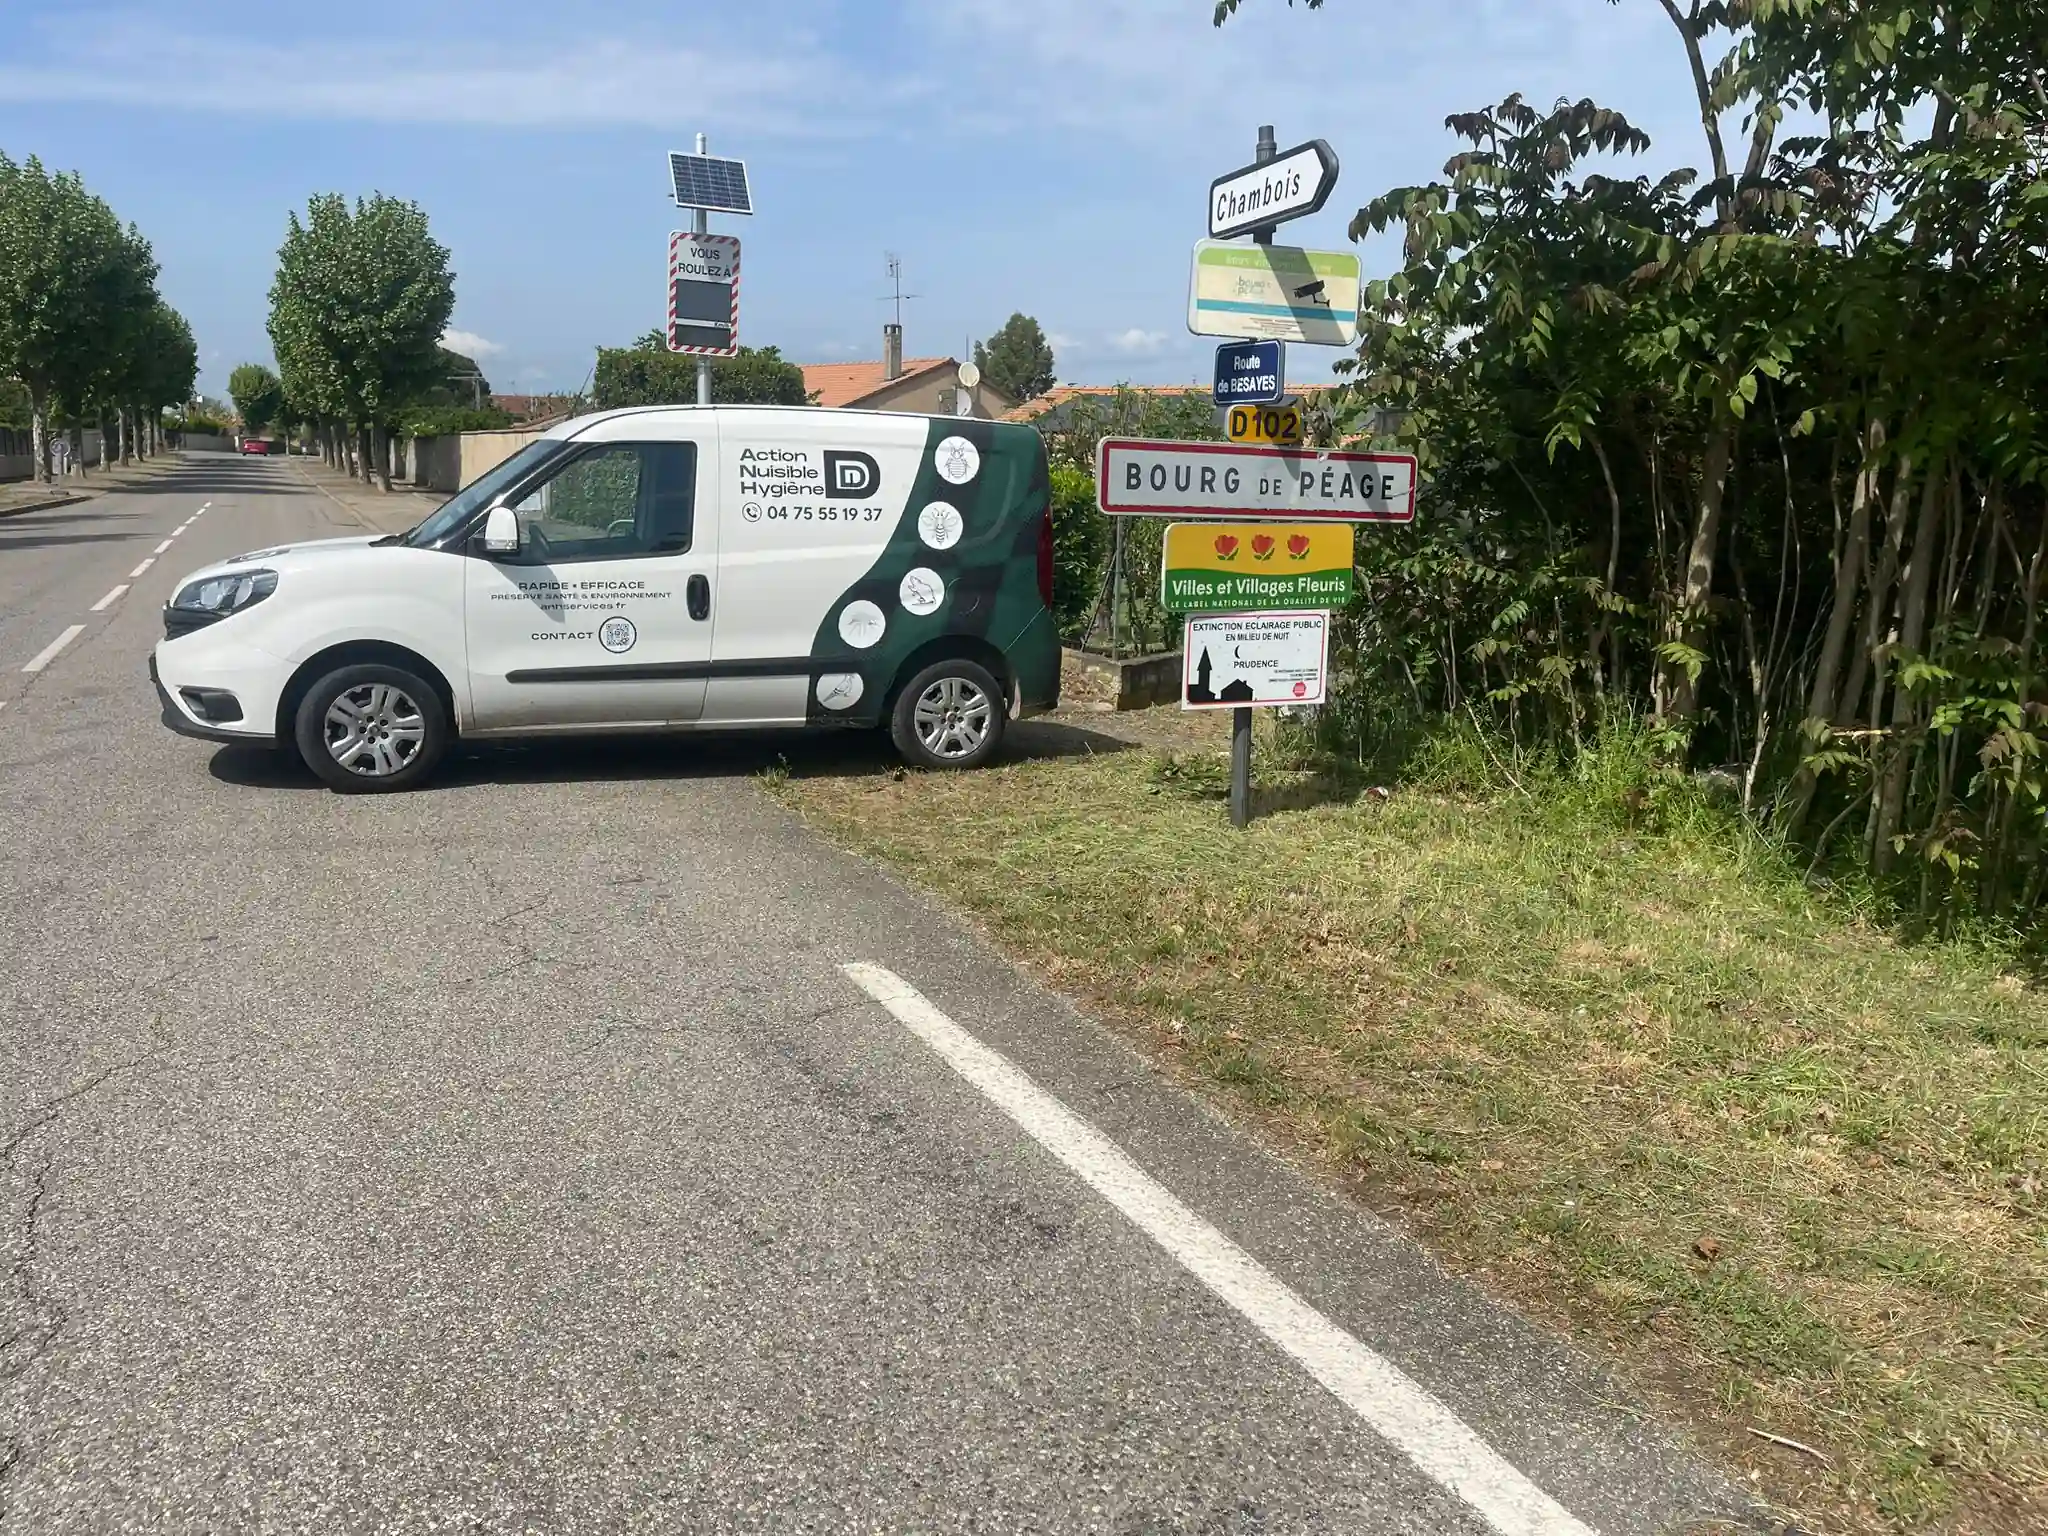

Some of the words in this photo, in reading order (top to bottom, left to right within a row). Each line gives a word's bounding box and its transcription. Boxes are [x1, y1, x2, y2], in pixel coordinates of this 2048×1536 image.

[1217, 168, 1300, 221] Chambois
[691, 247, 720, 260] VOUS
[678, 262, 721, 276] ROULEZ
[724, 264, 731, 277] À
[1234, 354, 1260, 370] Route
[1218, 379, 1228, 393] de
[1231, 375, 1275, 393] BESAYES
[740, 448, 807, 462] Action
[740, 465, 818, 478] Nuisible
[1126, 462, 1240, 494] BOURG
[1260, 478, 1282, 496] DE
[1300, 466, 1394, 500] PÉAGE
[740, 481, 824, 498] Hygiène
[767, 506, 788, 520] 04
[794, 506, 813, 520] 75
[818, 507, 837, 520] 55
[842, 508, 858, 521] 19
[864, 508, 882, 521] 37
[519, 582, 569, 590] RAPIDE
[581, 582, 644, 590] EFFICACE
[1172, 579, 1213, 596] Villes
[1217, 580, 1232, 594] et
[1236, 578, 1294, 597] Villages
[1298, 577, 1345, 593] Fleuris
[1183, 600, 1208, 608] LABEL
[1284, 596, 1317, 605] QUALITÉ
[1193, 622, 1242, 632] EXTINCTION
[1245, 621, 1290, 630] ECLAIRAGE
[1293, 620, 1322, 628] PUBLIC
[532, 632, 594, 640] CONTACT
[1237, 633, 1260, 641] MILIEU
[1274, 632, 1290, 640] NUIT
[1234, 660, 1278, 668] PRUDENCE
